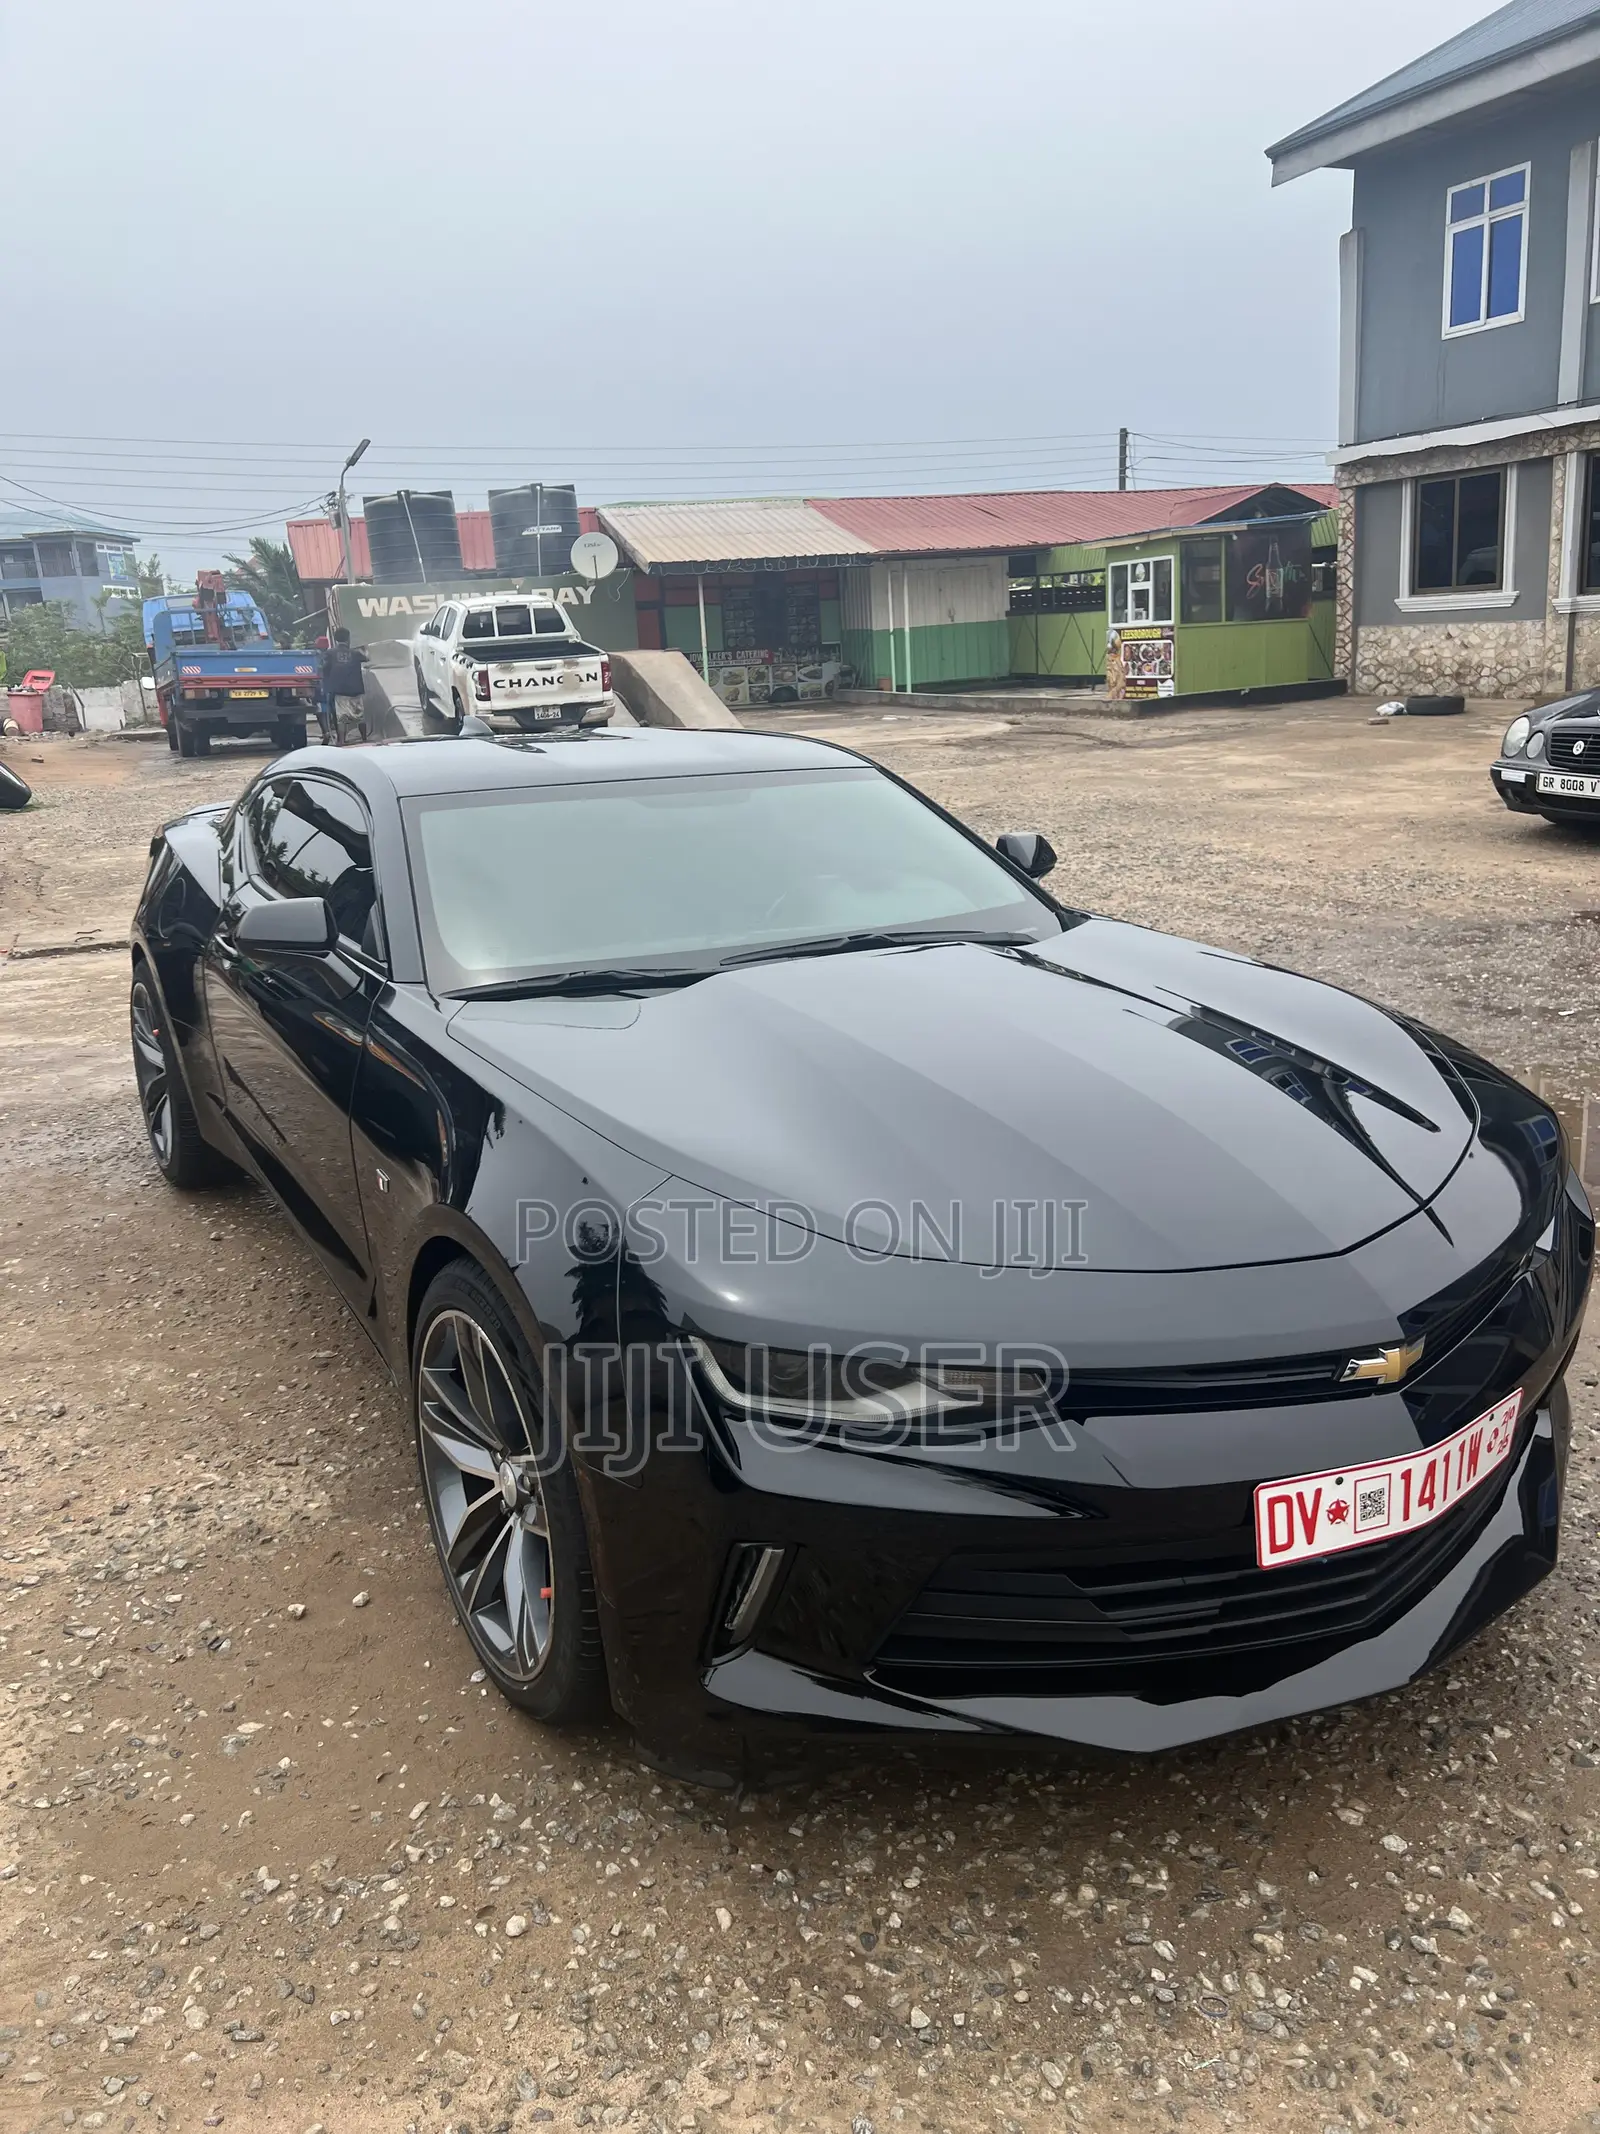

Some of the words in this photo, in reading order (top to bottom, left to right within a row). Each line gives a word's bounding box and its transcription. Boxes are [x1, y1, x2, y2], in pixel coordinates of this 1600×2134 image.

[357, 590, 518, 618] WASH
[1542, 776, 1555, 789] GR
[1560, 779, 1585, 792] 8008
[1267, 1487, 1322, 1554] DV
